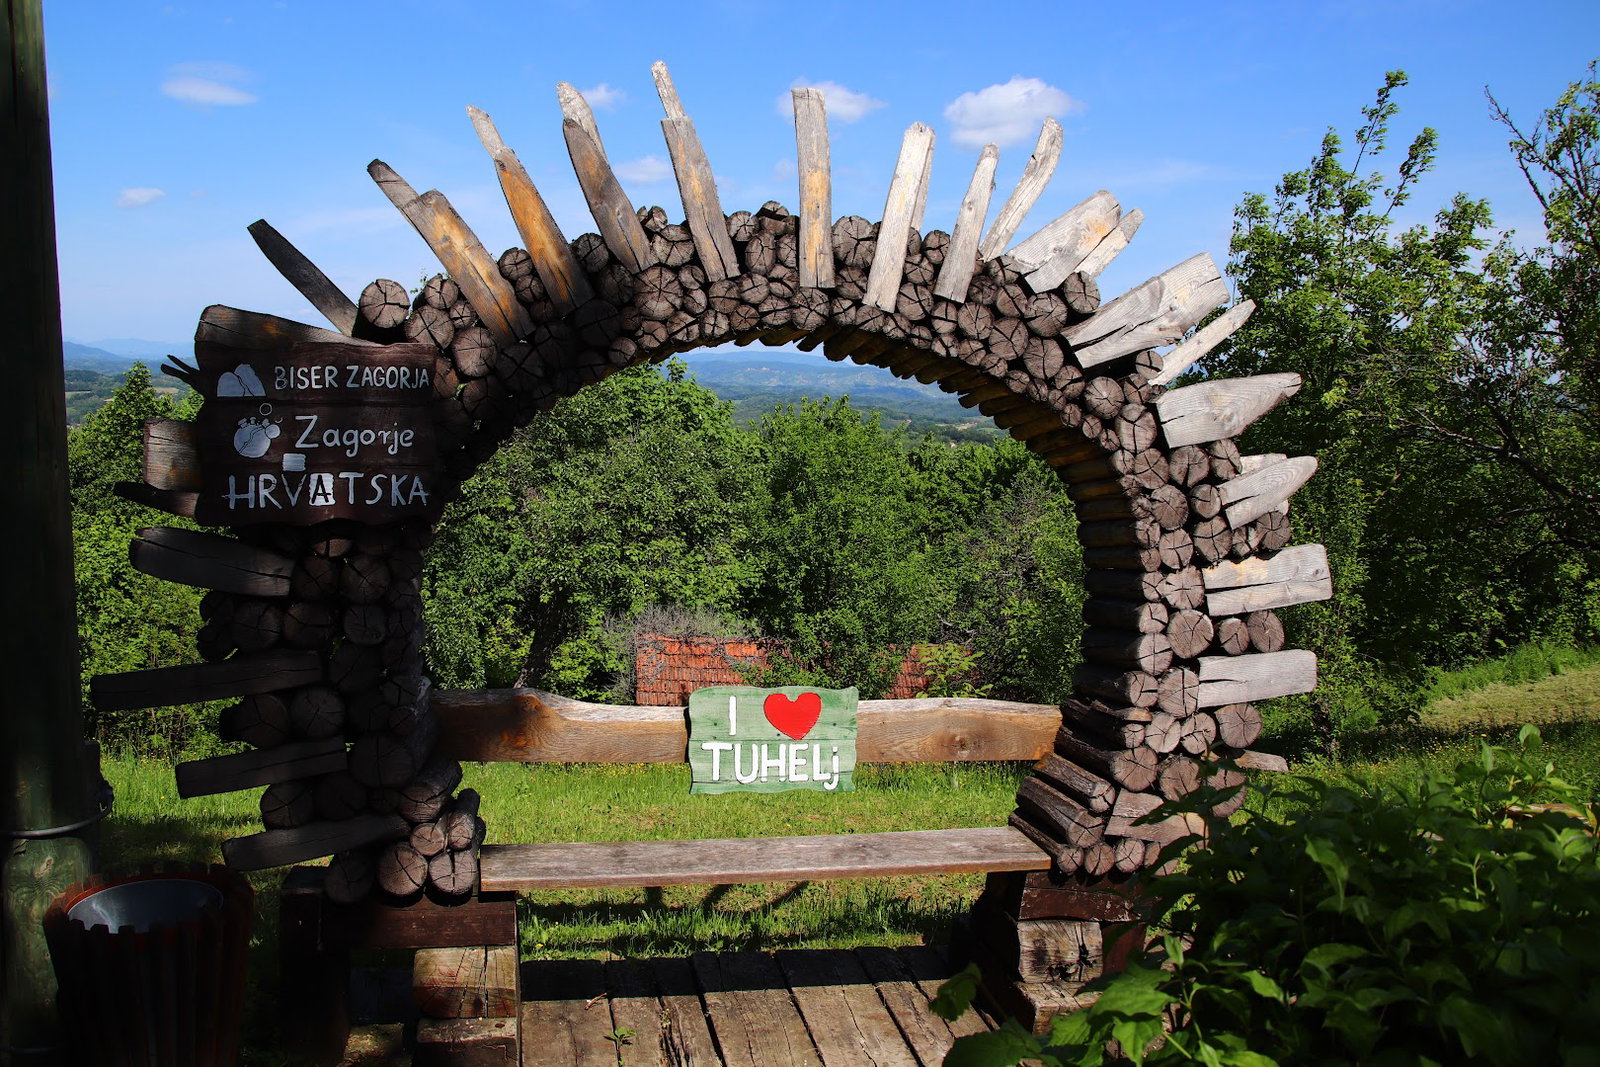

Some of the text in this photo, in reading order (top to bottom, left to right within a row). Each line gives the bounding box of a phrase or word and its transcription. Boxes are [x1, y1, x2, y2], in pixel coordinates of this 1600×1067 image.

[275, 365, 430, 390] BISER ZAGORJA
[295, 415, 415, 458] Zagorje
[221, 472, 431, 510] HRVATSKA
[729, 695, 737, 736] I
